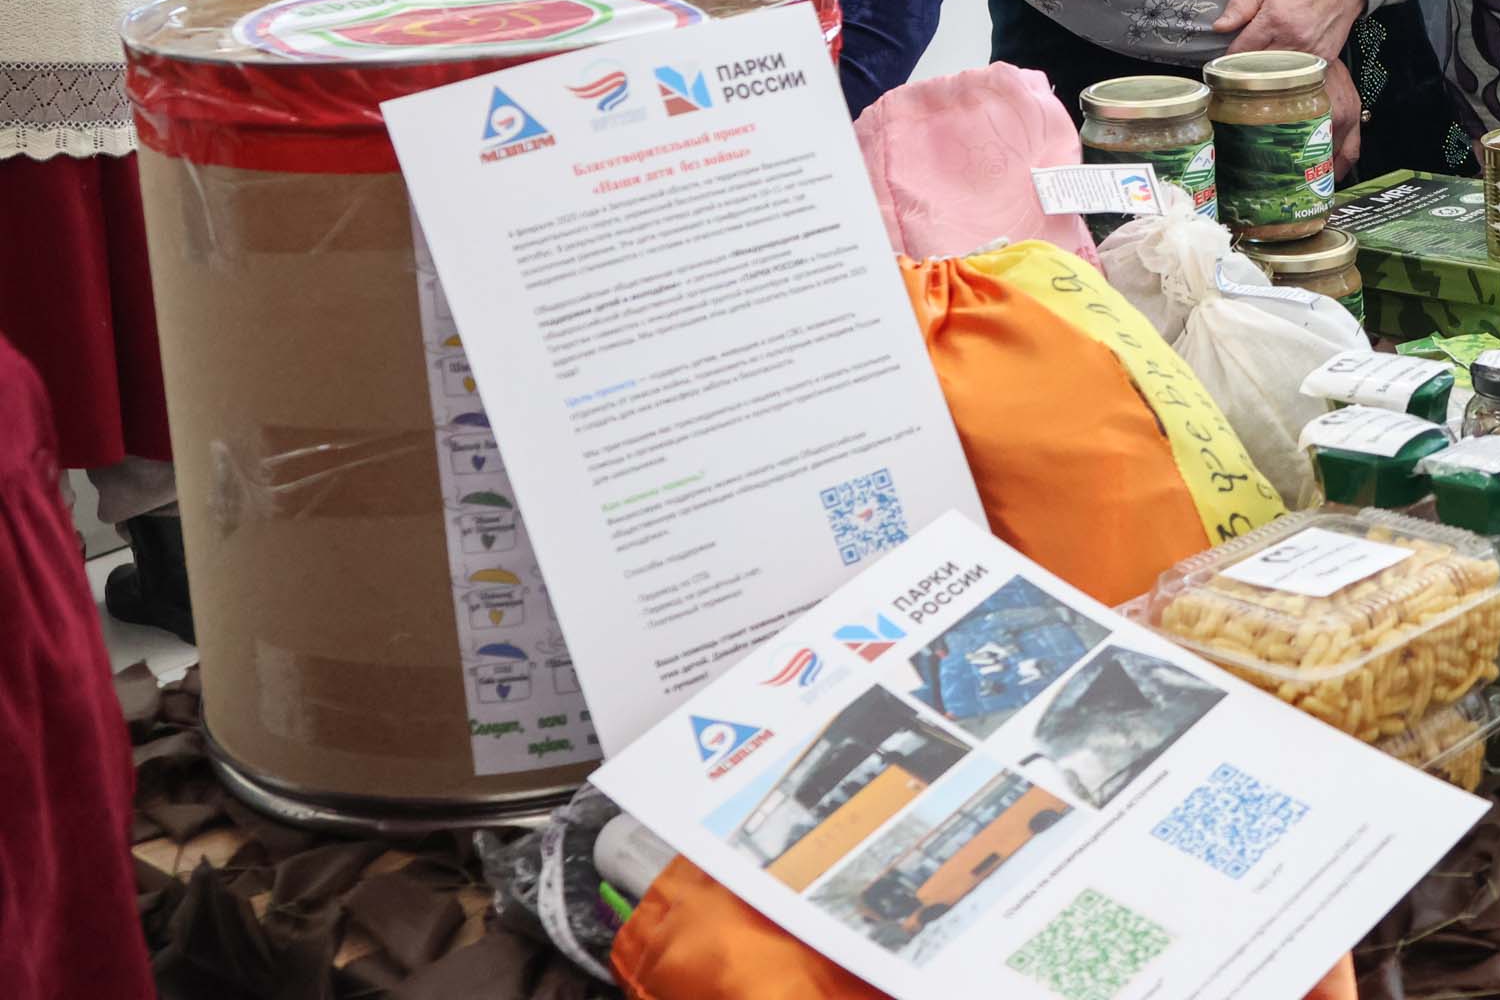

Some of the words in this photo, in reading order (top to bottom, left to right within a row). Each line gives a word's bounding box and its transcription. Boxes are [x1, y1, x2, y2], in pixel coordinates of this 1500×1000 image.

[716, 53, 786, 82] ПАРКИ
[722, 70, 807, 103] РОССИИ
[1370, 184, 1422, 204] MRE
[1294, 202, 1329, 220] КОНИНА
[893, 560, 960, 613] ПАРКИ
[909, 563, 989, 625] РОССИИ
